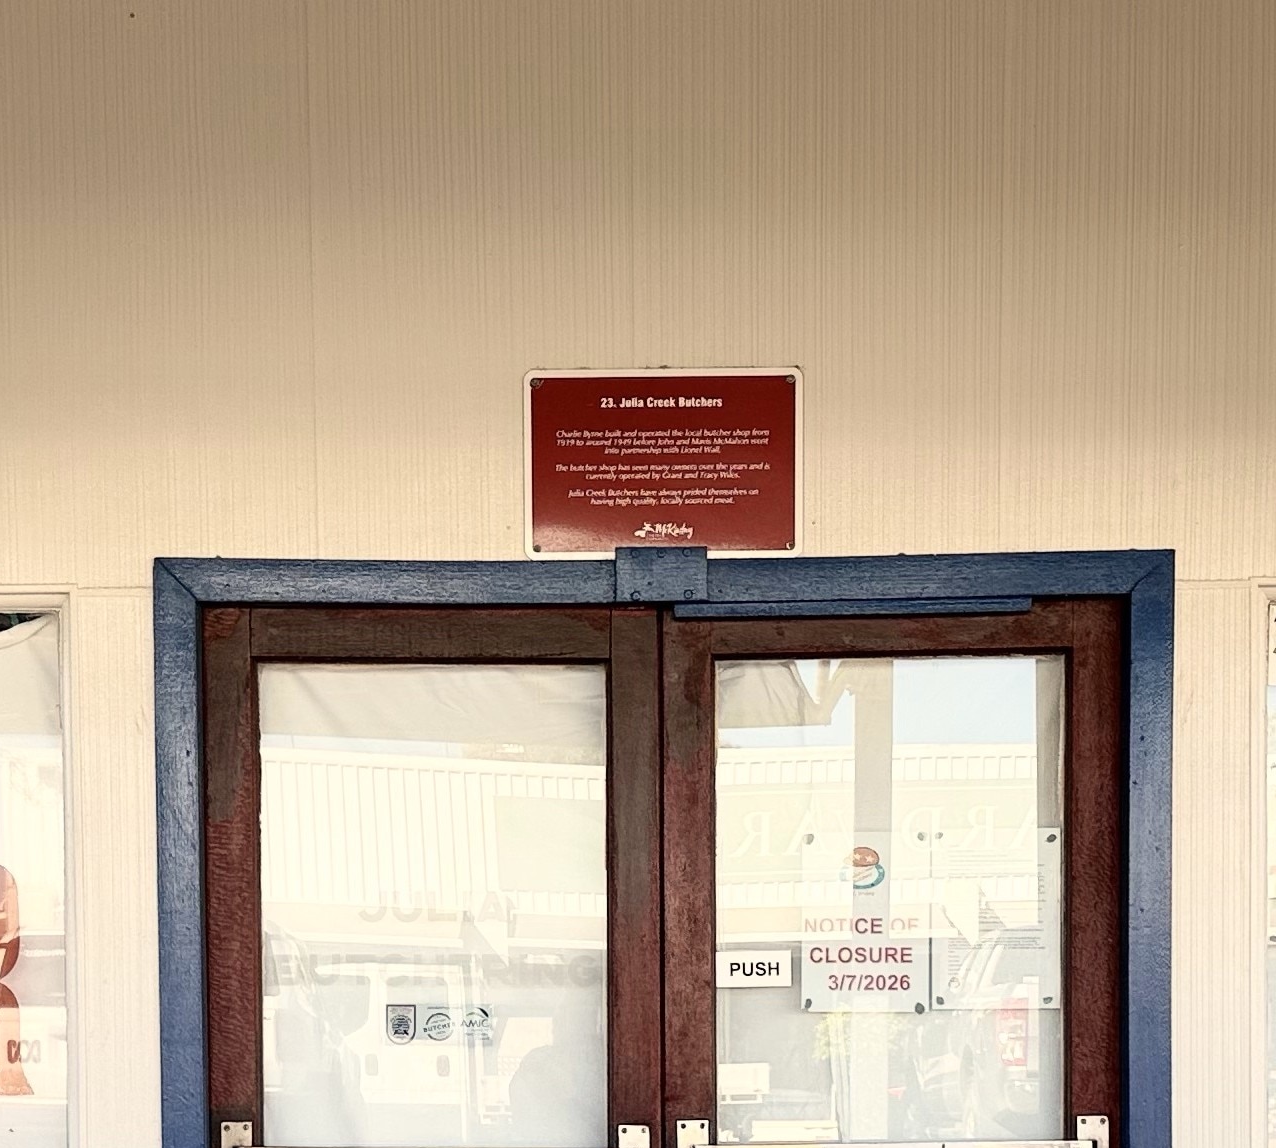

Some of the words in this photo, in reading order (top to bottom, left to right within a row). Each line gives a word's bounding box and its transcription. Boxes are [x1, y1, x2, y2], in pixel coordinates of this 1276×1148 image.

[600, 397, 617, 408] 23.
[619, 397, 644, 408] Julia
[646, 397, 676, 408] Creek
[678, 396, 723, 408] Butchers
[556, 429, 582, 438] Charlie
[623, 429, 638, 437] and
[638, 429, 670, 440] operated
[671, 429, 684, 437] the
[685, 428, 703, 437] local
[703, 428, 732, 437] butcher
[732, 429, 751, 438] shop
[752, 428, 770, 437] from
[632, 438, 656, 446] before
[676, 438, 690, 446] and
[620, 446, 662, 457] partnership
[663, 446, 680, 455] with
[680, 446, 703, 455] Lionel
[555, 463, 569, 472] The
[598, 463, 617, 472] shop
[618, 463, 631, 471] has
[715, 462, 729, 471] the
[729, 462, 748, 474] years
[748, 462, 764, 471] and
[585, 471, 617, 481] currently
[618, 471, 651, 482] operated
[651, 471, 661, 481] by
[683, 471, 699, 479] and
[585, 488, 606, 497] Creek
[607, 488, 638, 497] Butchers
[640, 488, 657, 497] have
[682, 487, 707, 499] prided
[708, 487, 748, 496] themselves
[590, 498, 614, 507] having
[615, 497, 631, 507] high
[660, 496, 684, 506] locally
[684, 496, 714, 505] sourced
[804, 917, 884, 934] NOTICE
[809, 946, 913, 964] CLOSURE
[729, 962, 781, 977] PUSH
[827, 974, 911, 991] 3/7/2026
